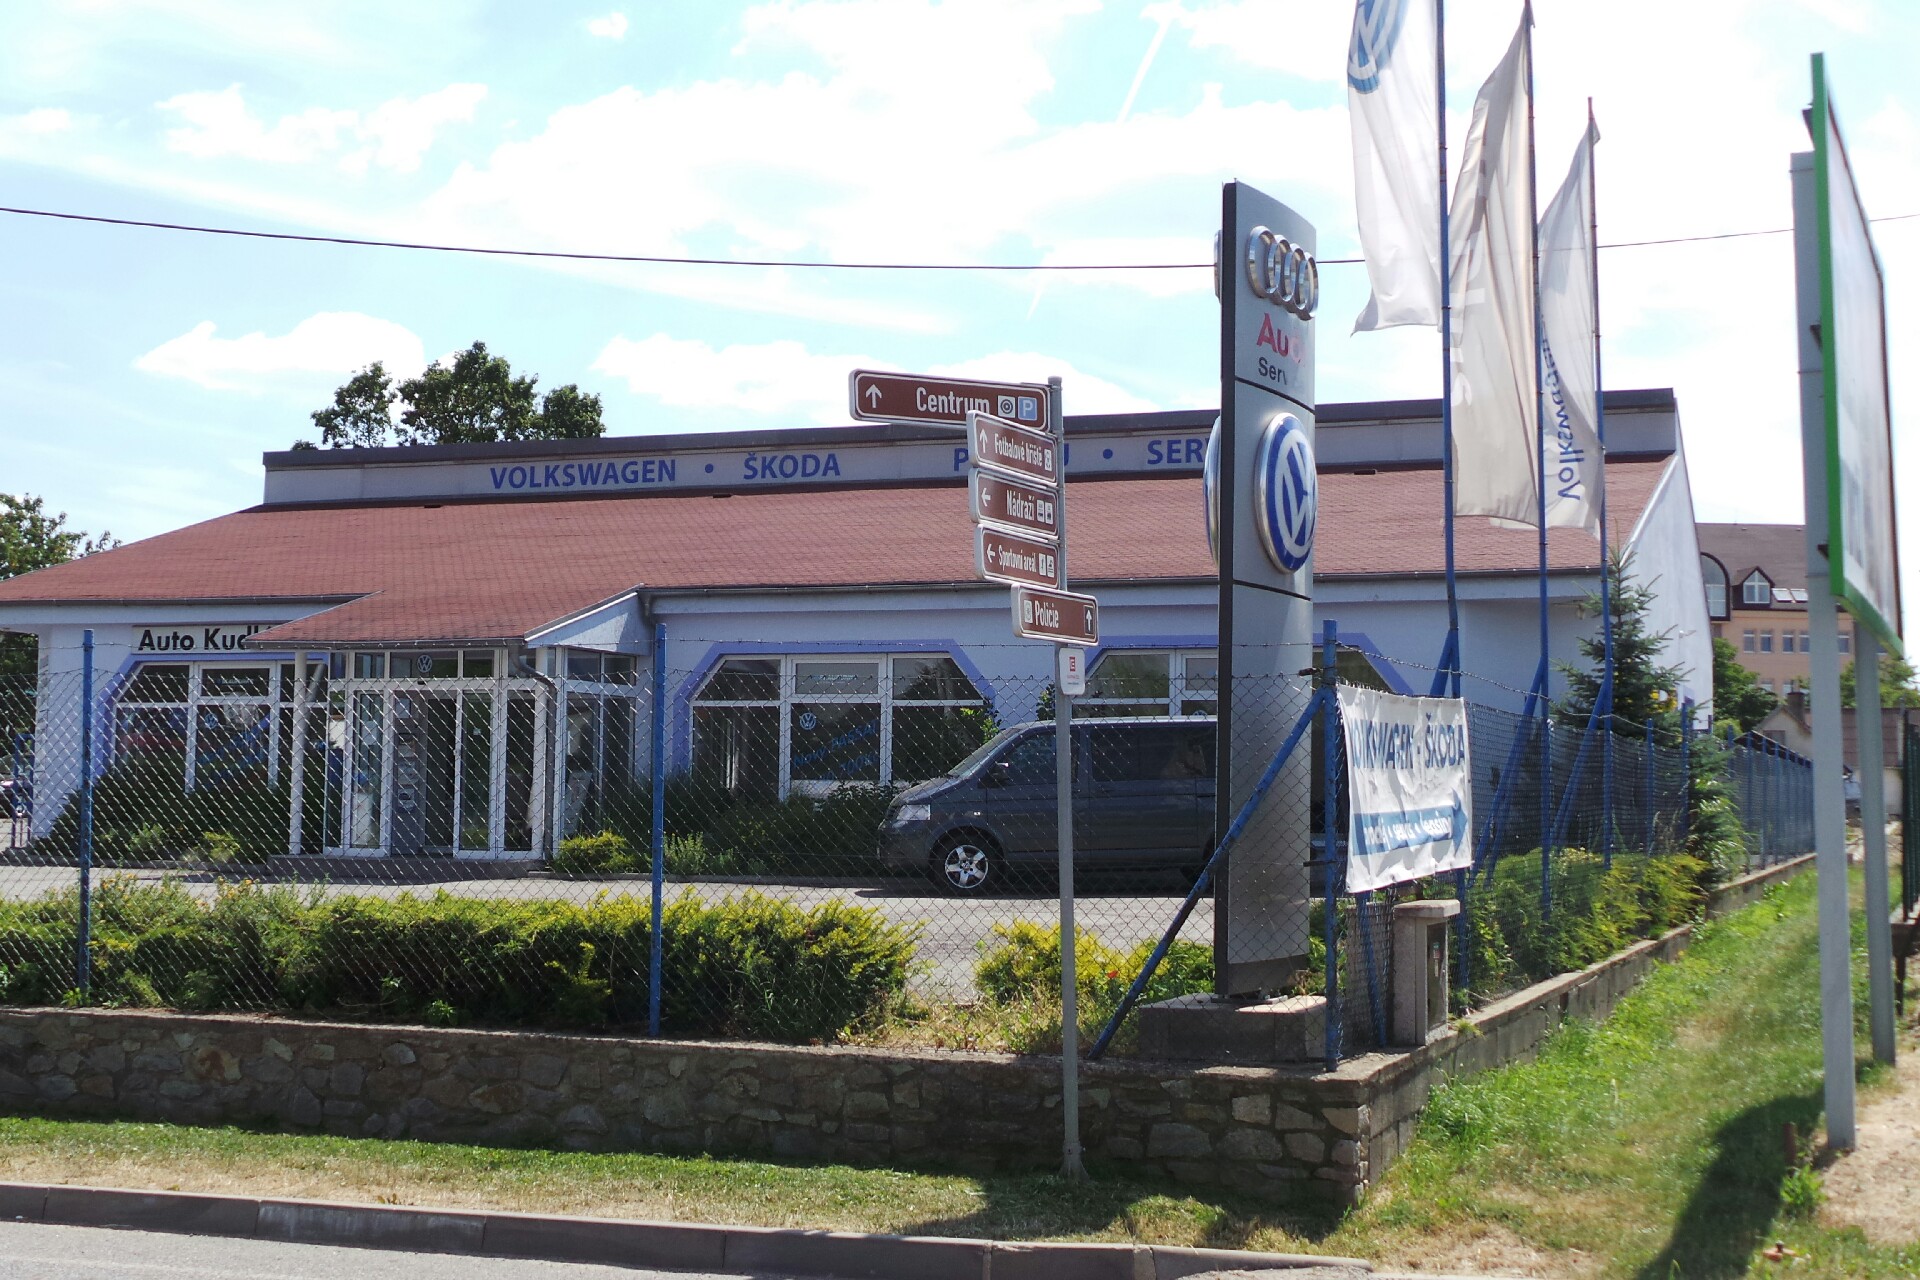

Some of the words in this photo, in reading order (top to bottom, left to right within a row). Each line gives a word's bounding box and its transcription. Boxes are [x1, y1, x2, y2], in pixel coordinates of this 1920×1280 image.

[916, 386, 990, 414] Centrum
[994, 432, 1025, 461] Fotbalové
[1146, 438, 1207, 465] SER
[490, 459, 677, 490] VOLKSWAGEN
[743, 451, 841, 481] ŠKODA
[1006, 489, 1035, 521] Nádraží
[1034, 600, 1059, 628] Policie
[138, 629, 195, 651] Auto
